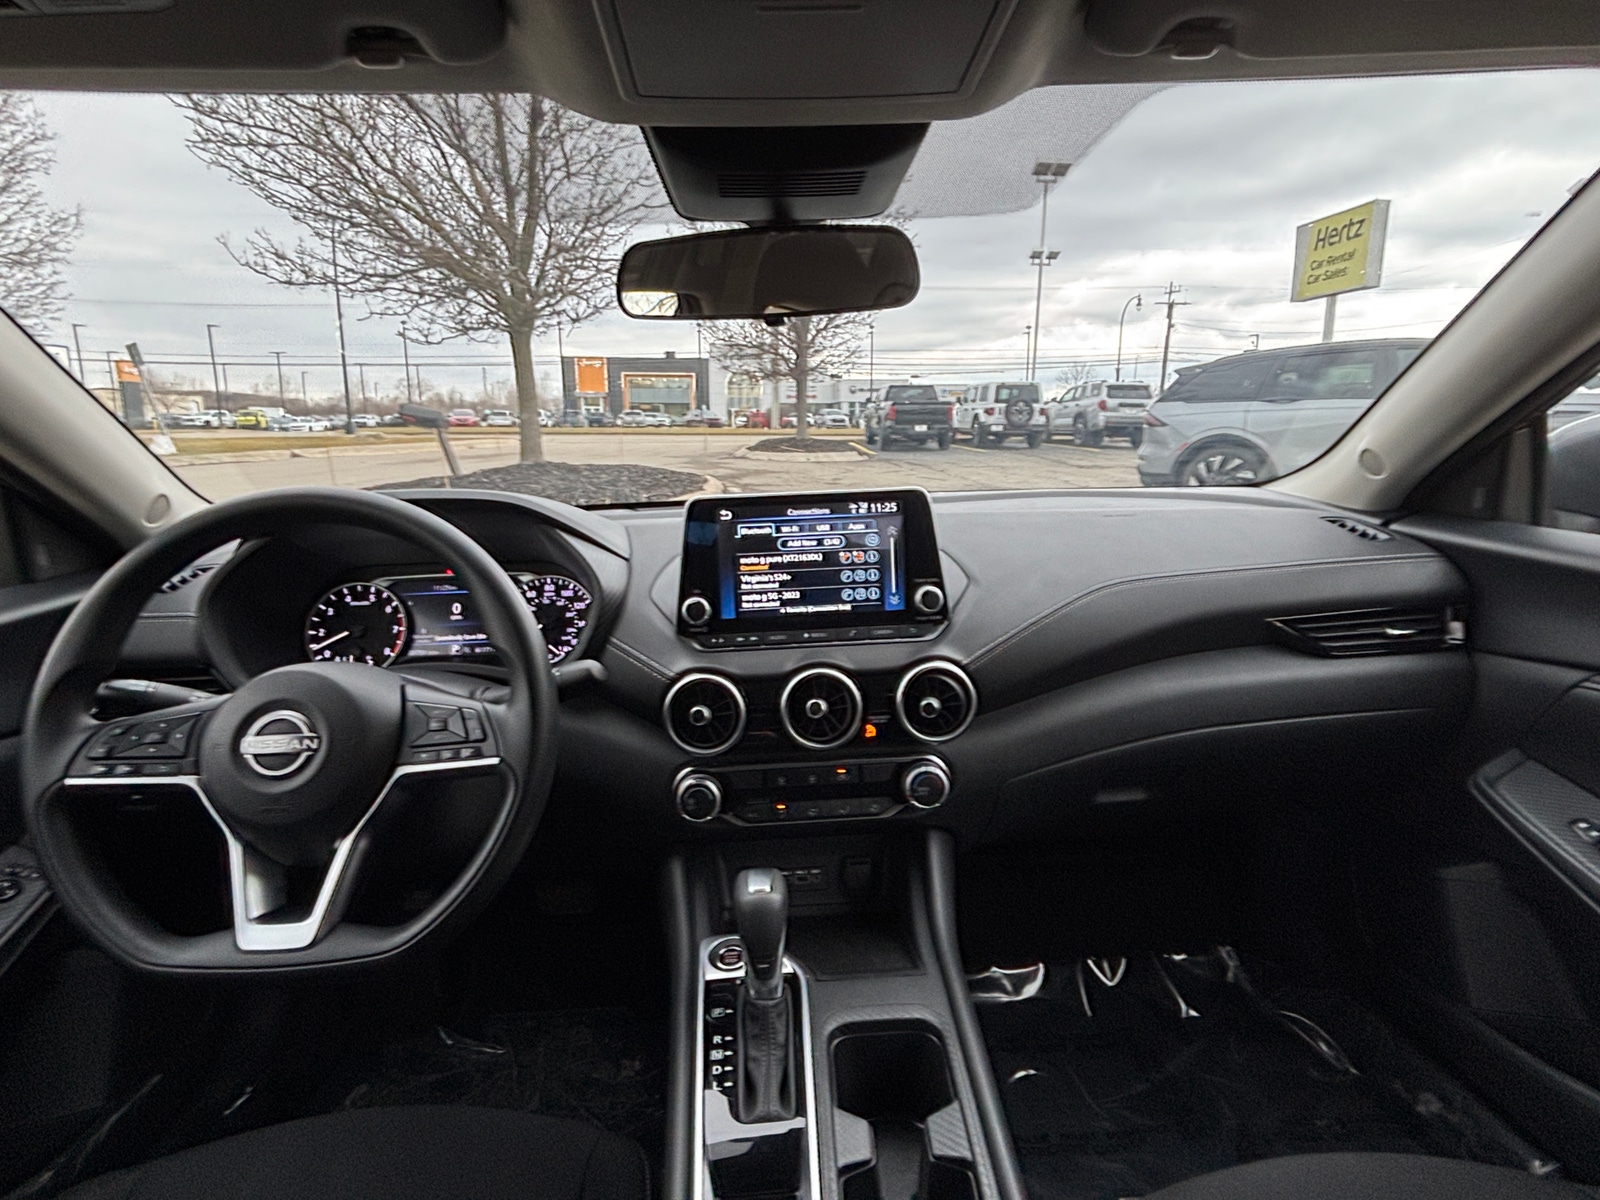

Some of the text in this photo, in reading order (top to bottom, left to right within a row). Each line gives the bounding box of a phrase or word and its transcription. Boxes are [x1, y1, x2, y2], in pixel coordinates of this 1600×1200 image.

[1314, 218, 1367, 251] Hertz
[1311, 248, 1356, 271] Car Rental
[1307, 266, 1348, 285] Car Sales
[870, 503, 898, 512] 11:25
[766, 556, 782, 564] pure
[767, 592, 778, 600] 5G
[782, 591, 801, 599] 2023
[451, 602, 462, 614] 0
[713, 1036, 723, 1044] R
[712, 1065, 723, 1075] D
[712, 1081, 723, 1091] L
